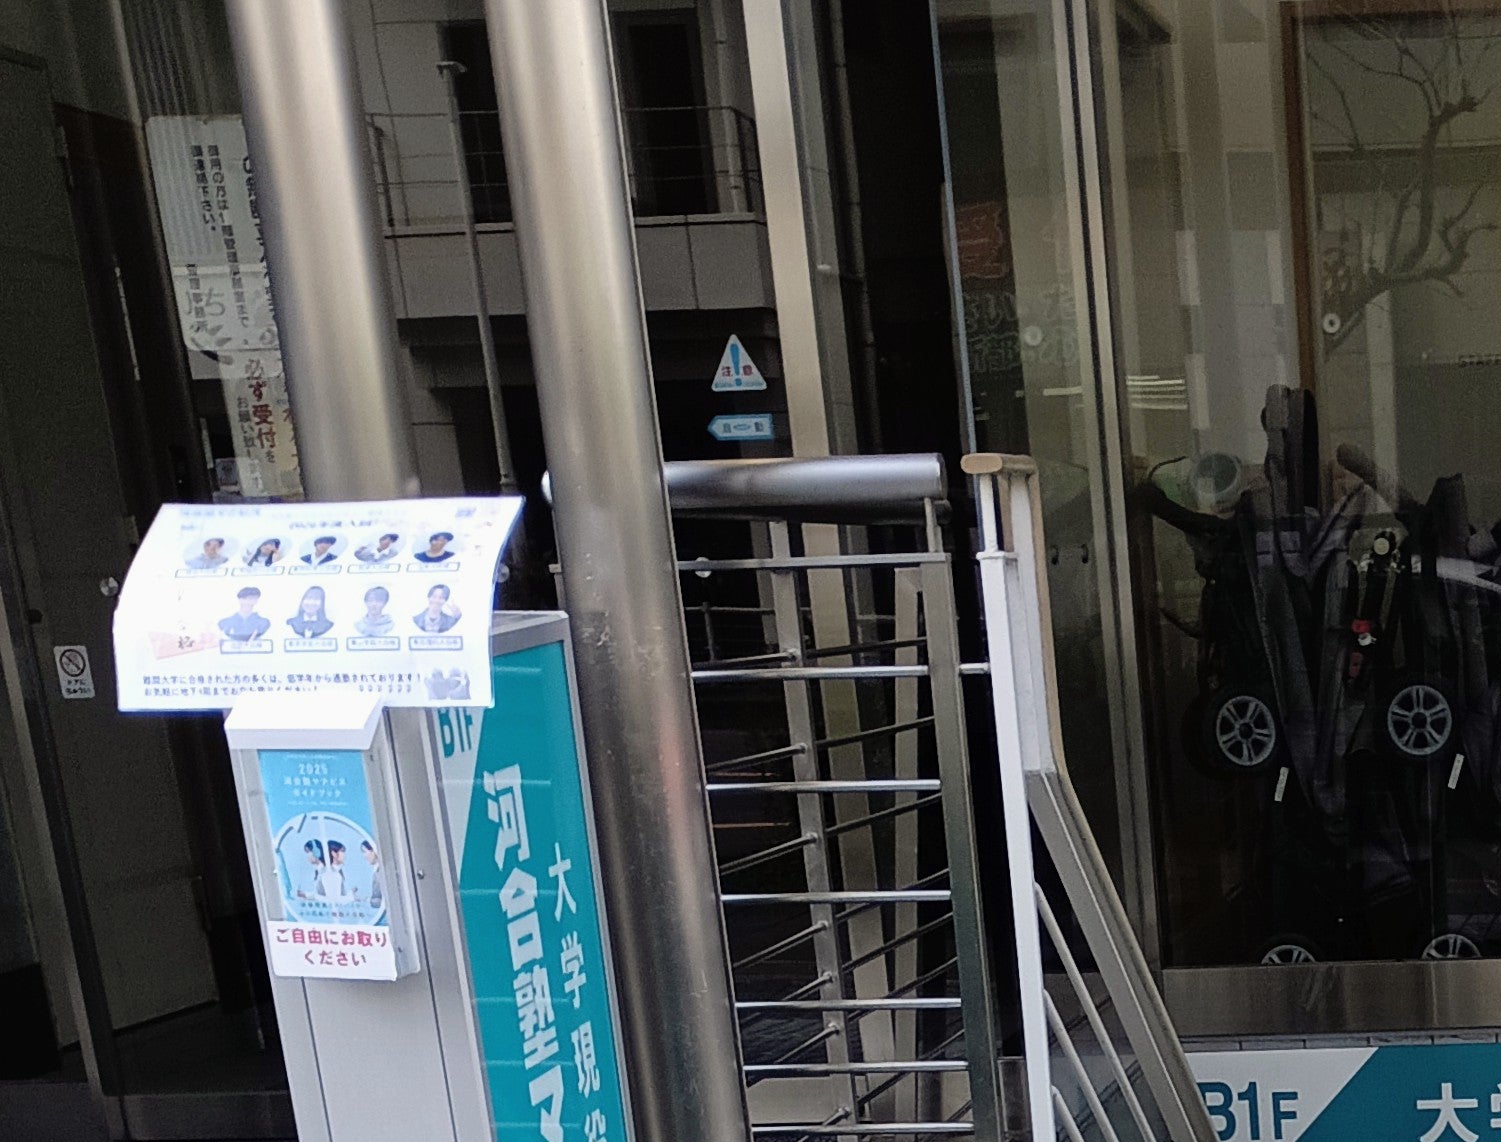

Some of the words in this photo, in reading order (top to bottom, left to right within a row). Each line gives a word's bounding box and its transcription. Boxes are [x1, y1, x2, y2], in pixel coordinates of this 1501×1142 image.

[276, 928, 387, 948] ご自由にお取り
[304, 950, 368, 967] ください
[1197, 1081, 1299, 1142] B1F
